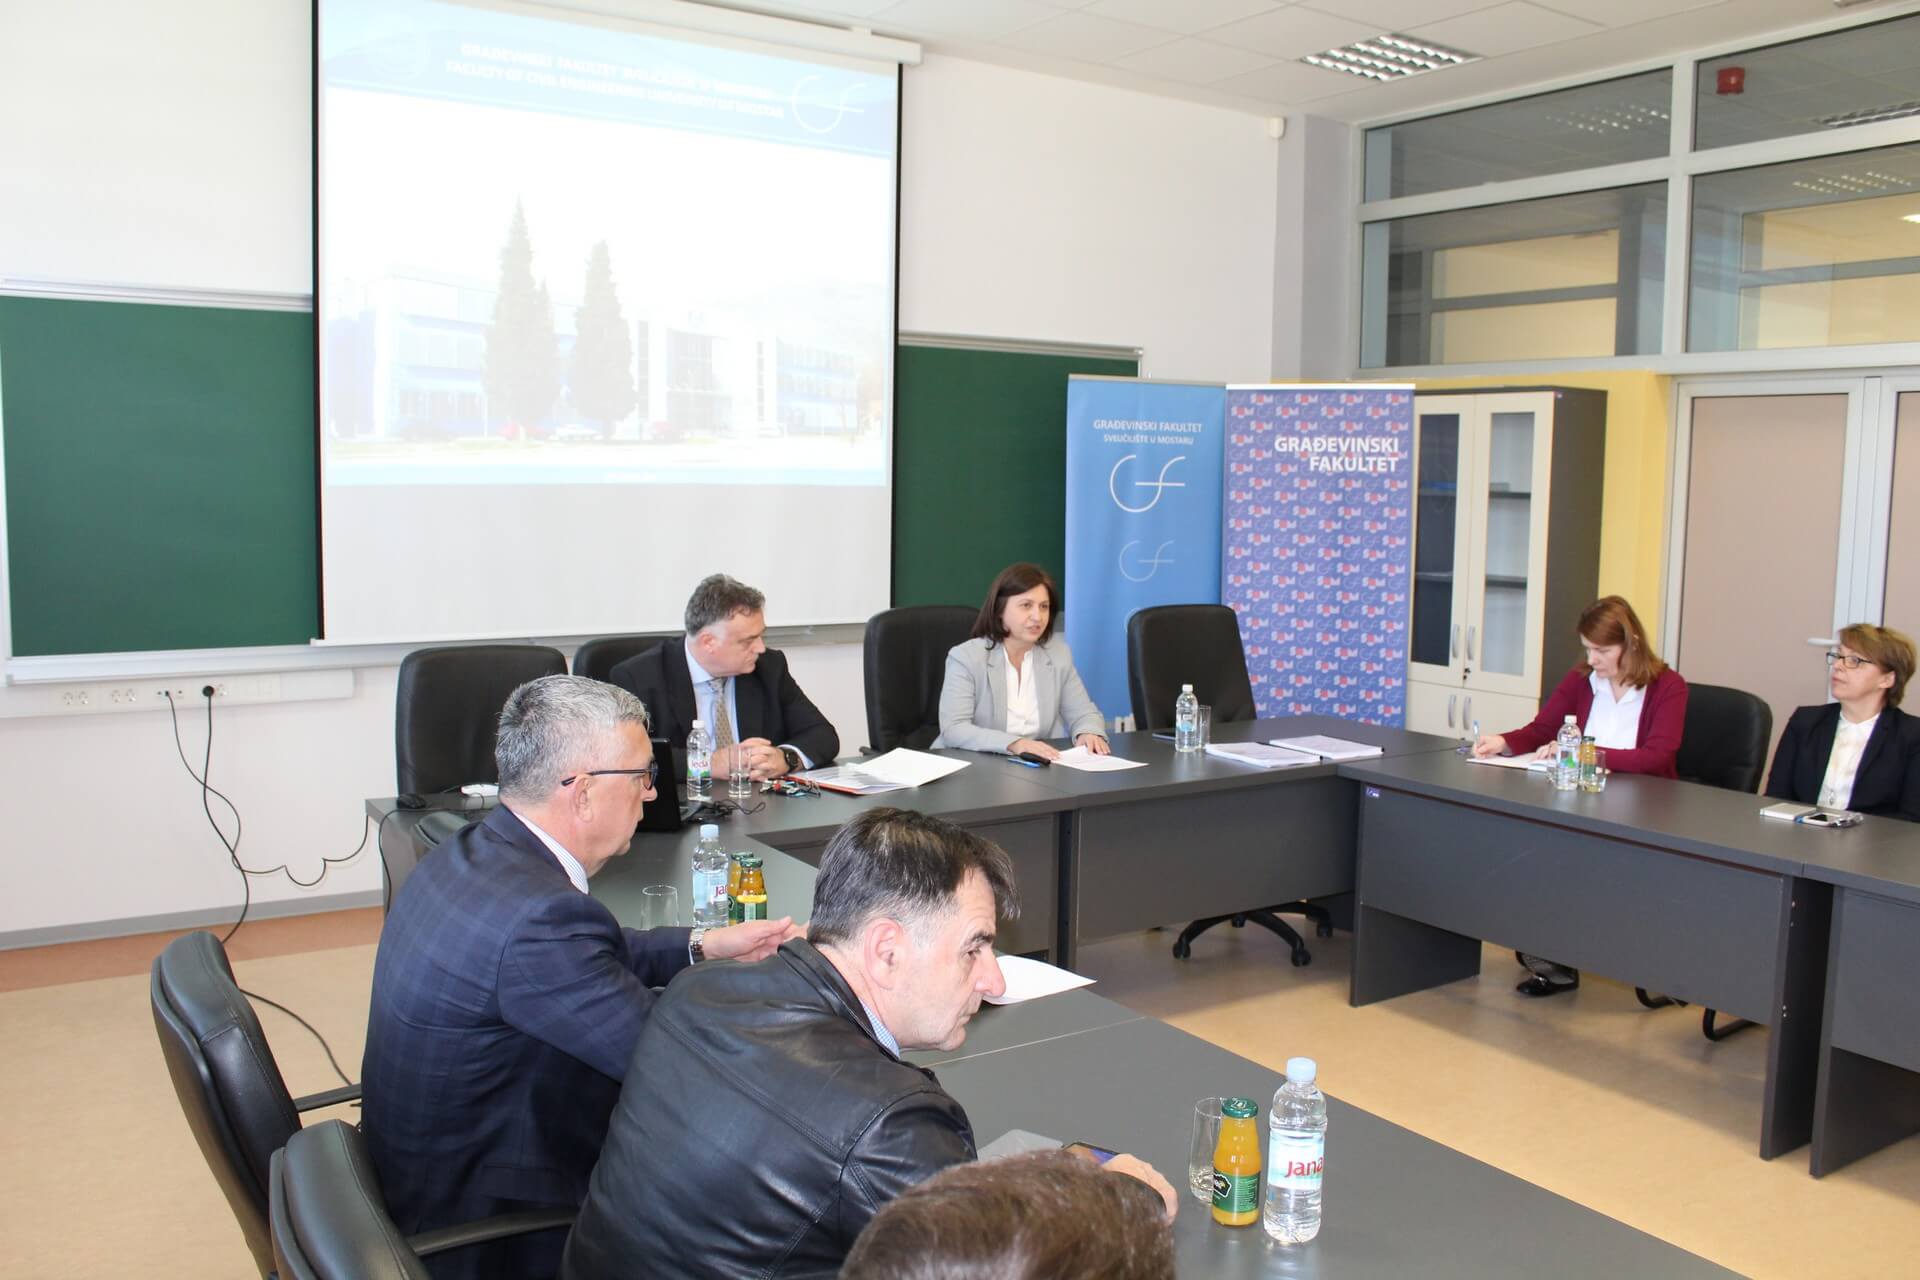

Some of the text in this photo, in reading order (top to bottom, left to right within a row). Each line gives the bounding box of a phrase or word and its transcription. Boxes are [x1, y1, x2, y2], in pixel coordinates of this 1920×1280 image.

[1159, 422, 1202, 433] FAKULTET
[1274, 436, 1399, 453] GRAĐEVINSKI
[1309, 456, 1399, 472] FAKULTET
